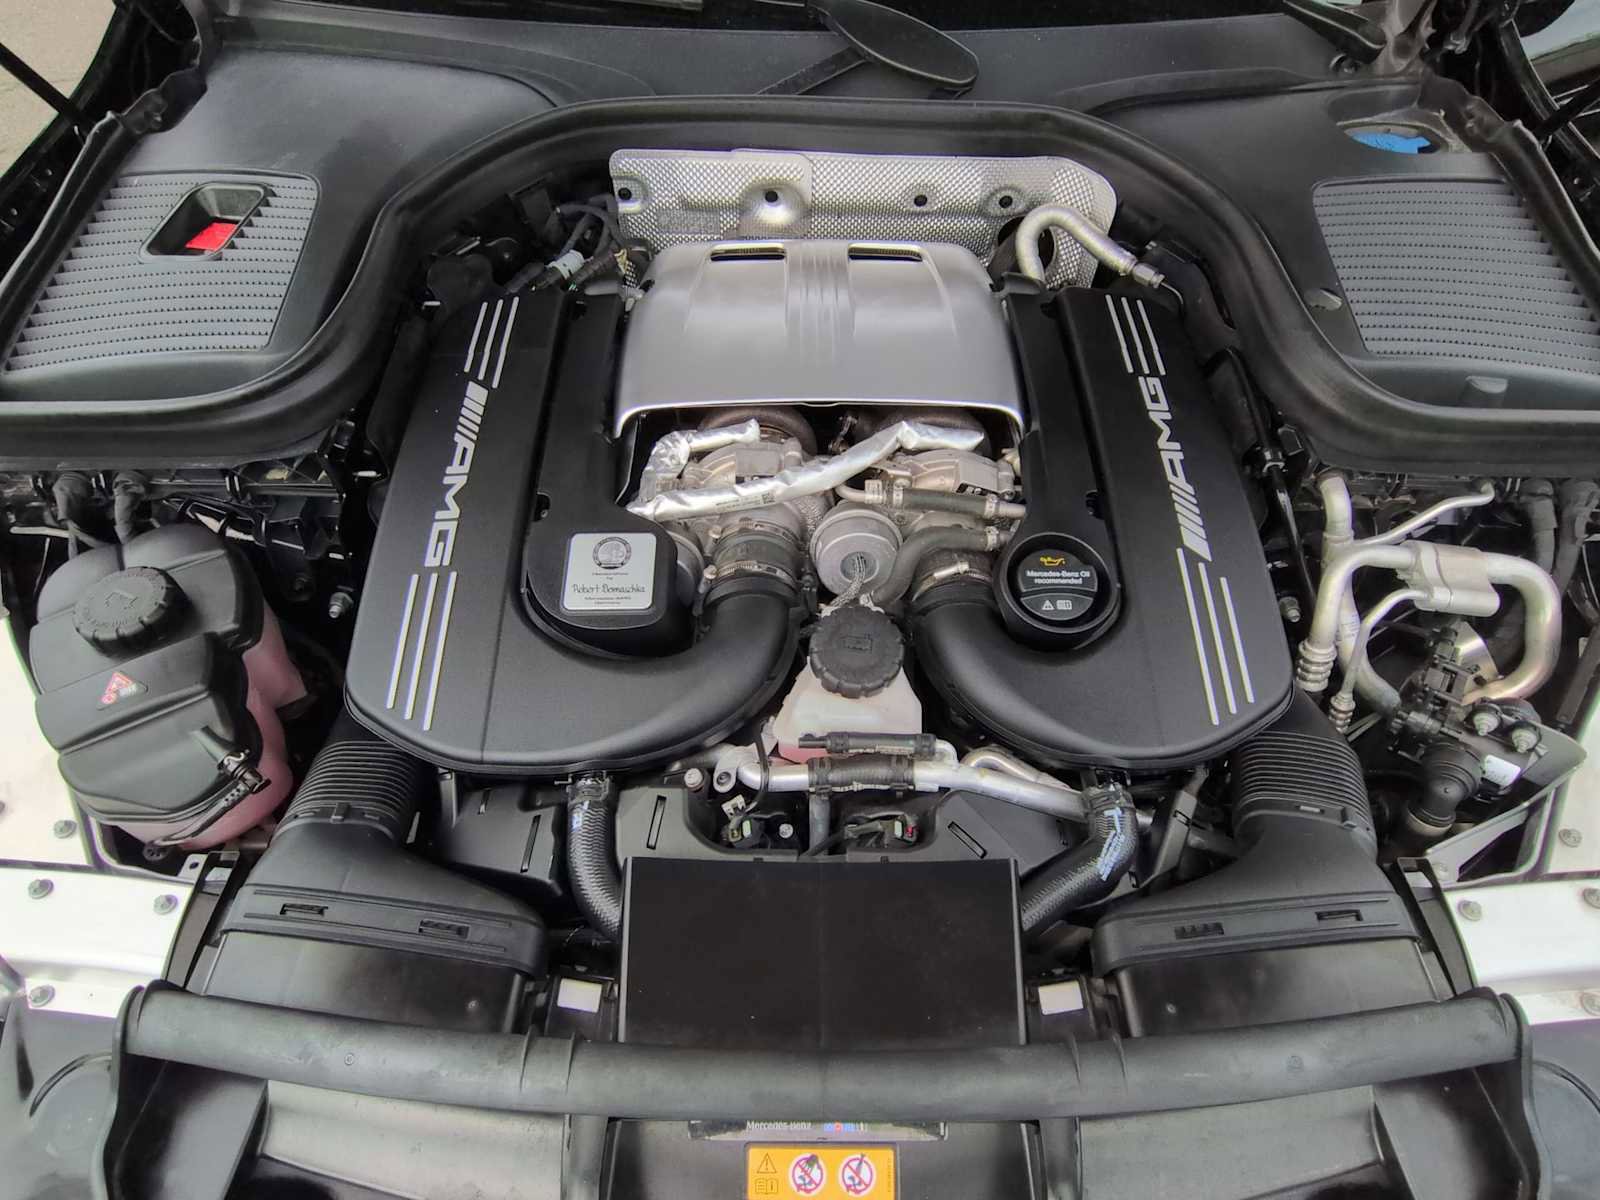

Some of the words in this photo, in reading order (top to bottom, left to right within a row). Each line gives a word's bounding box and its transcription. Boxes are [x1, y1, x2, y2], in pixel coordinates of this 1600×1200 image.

[1138, 376, 1195, 495] AMG
[424, 432, 476, 567] AMG
[1026, 570, 1079, 578] Mercedes-Benz
